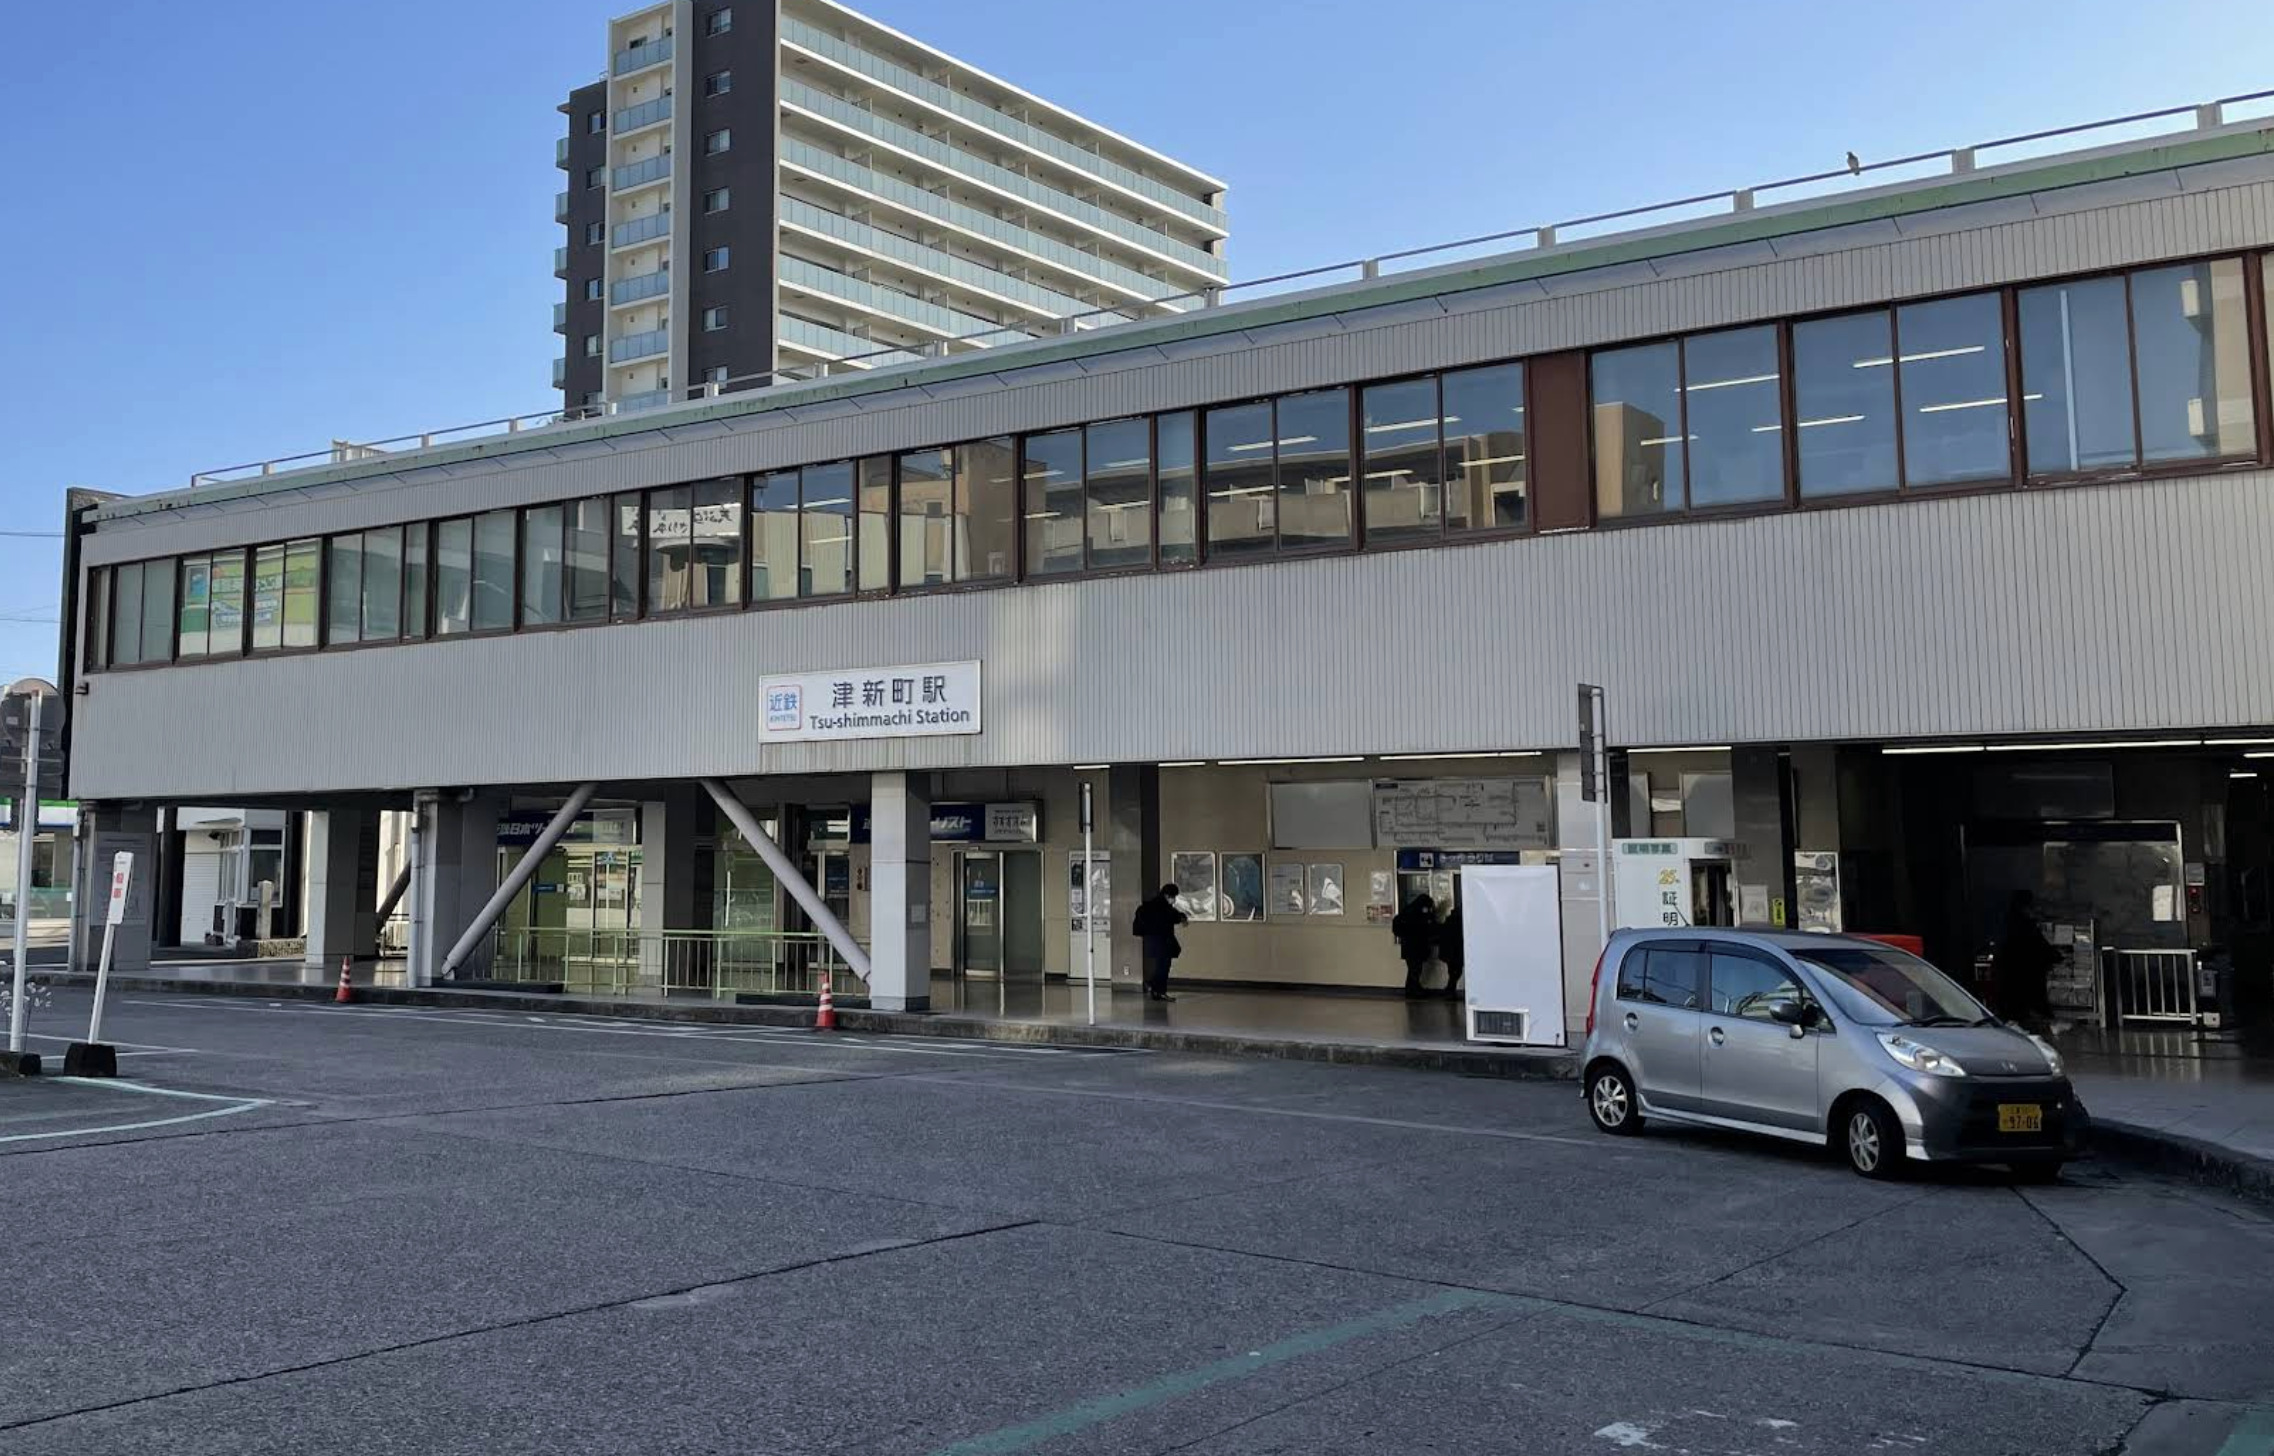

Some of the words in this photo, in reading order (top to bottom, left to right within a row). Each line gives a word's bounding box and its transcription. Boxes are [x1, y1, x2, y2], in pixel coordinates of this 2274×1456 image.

[769, 692, 797, 711] 近鉄
[832, 675, 947, 709] 津新町駅
[810, 709, 912, 729] Tsu-shimmachi
[916, 708, 970, 724] Station
